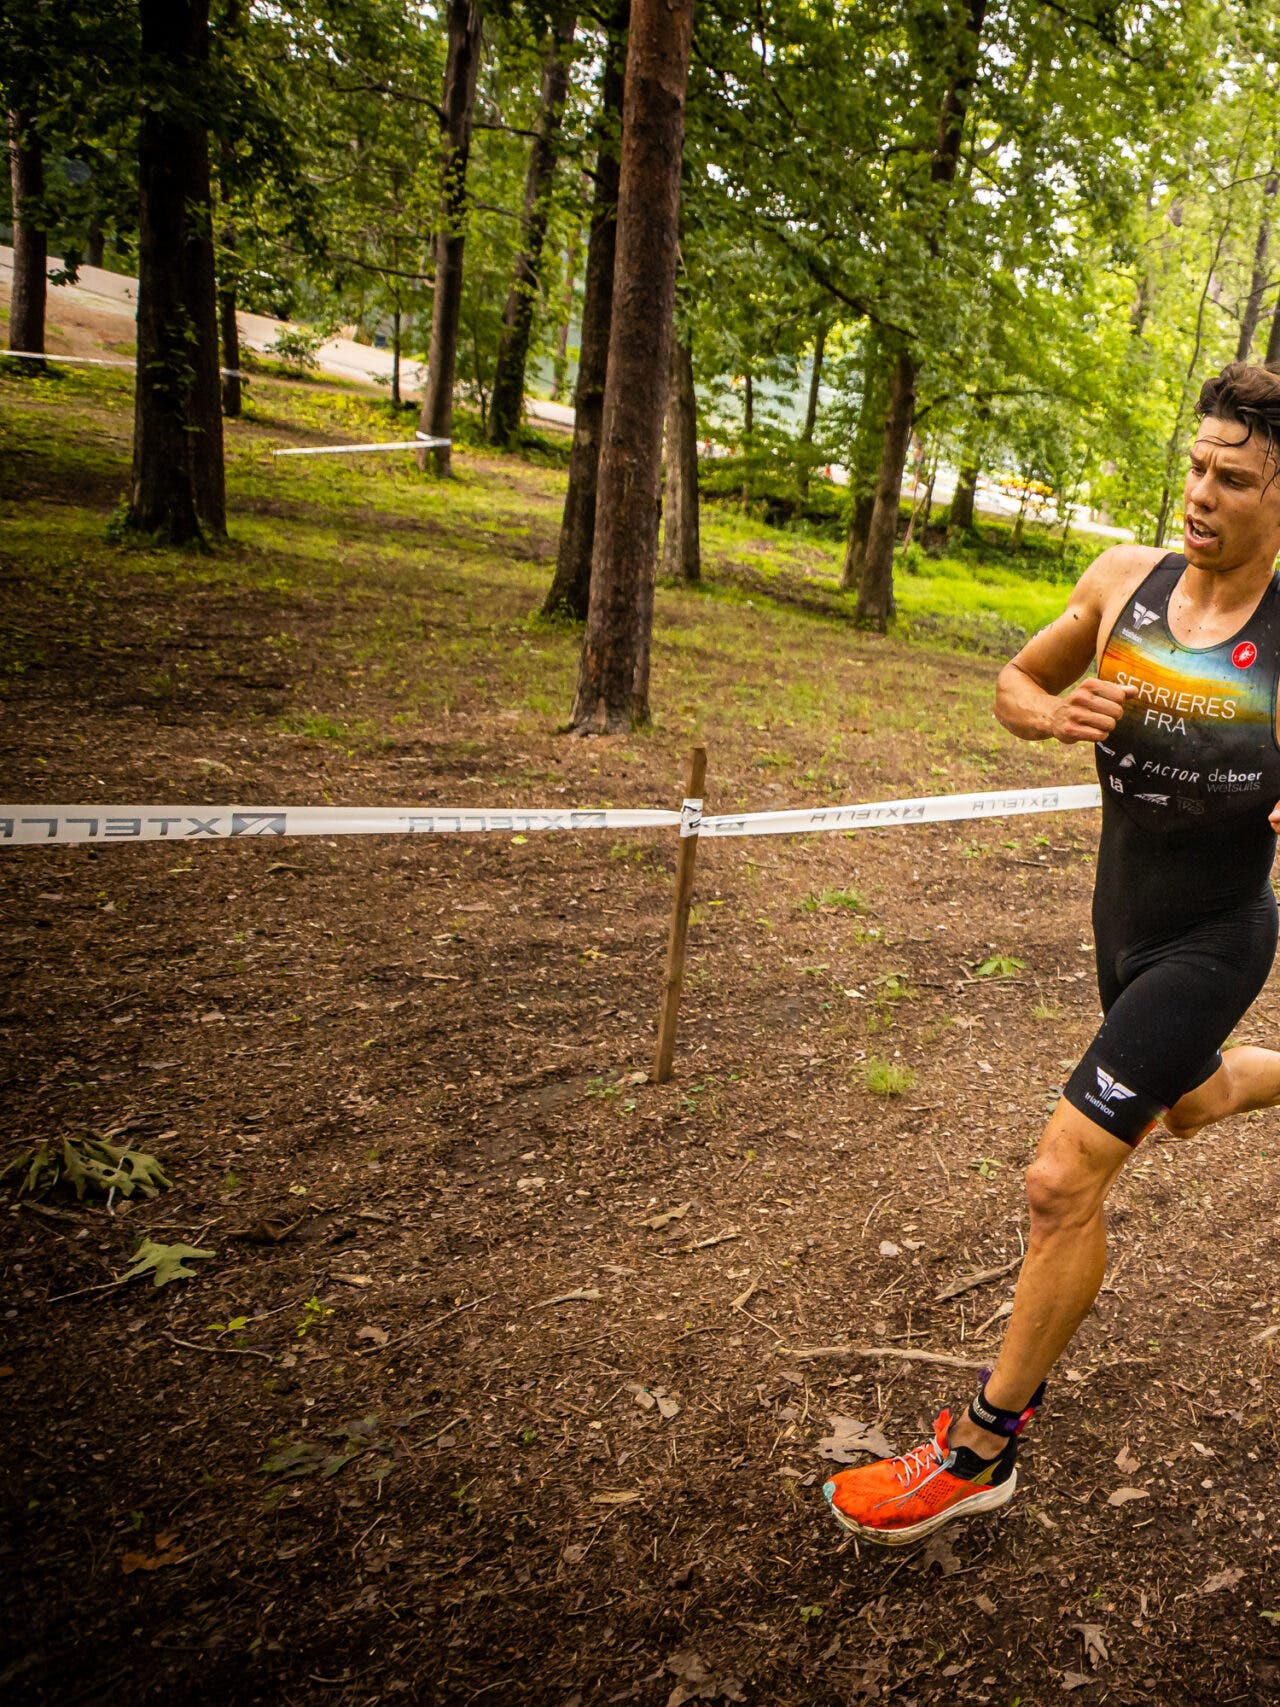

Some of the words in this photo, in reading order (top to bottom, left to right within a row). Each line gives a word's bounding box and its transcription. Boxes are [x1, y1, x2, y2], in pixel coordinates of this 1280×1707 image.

[1144, 709, 1186, 735] FRA
[1142, 761, 1200, 783] FACTOR
[1208, 768, 1262, 783] deboer
[1084, 1092, 1115, 1118] triathlon
